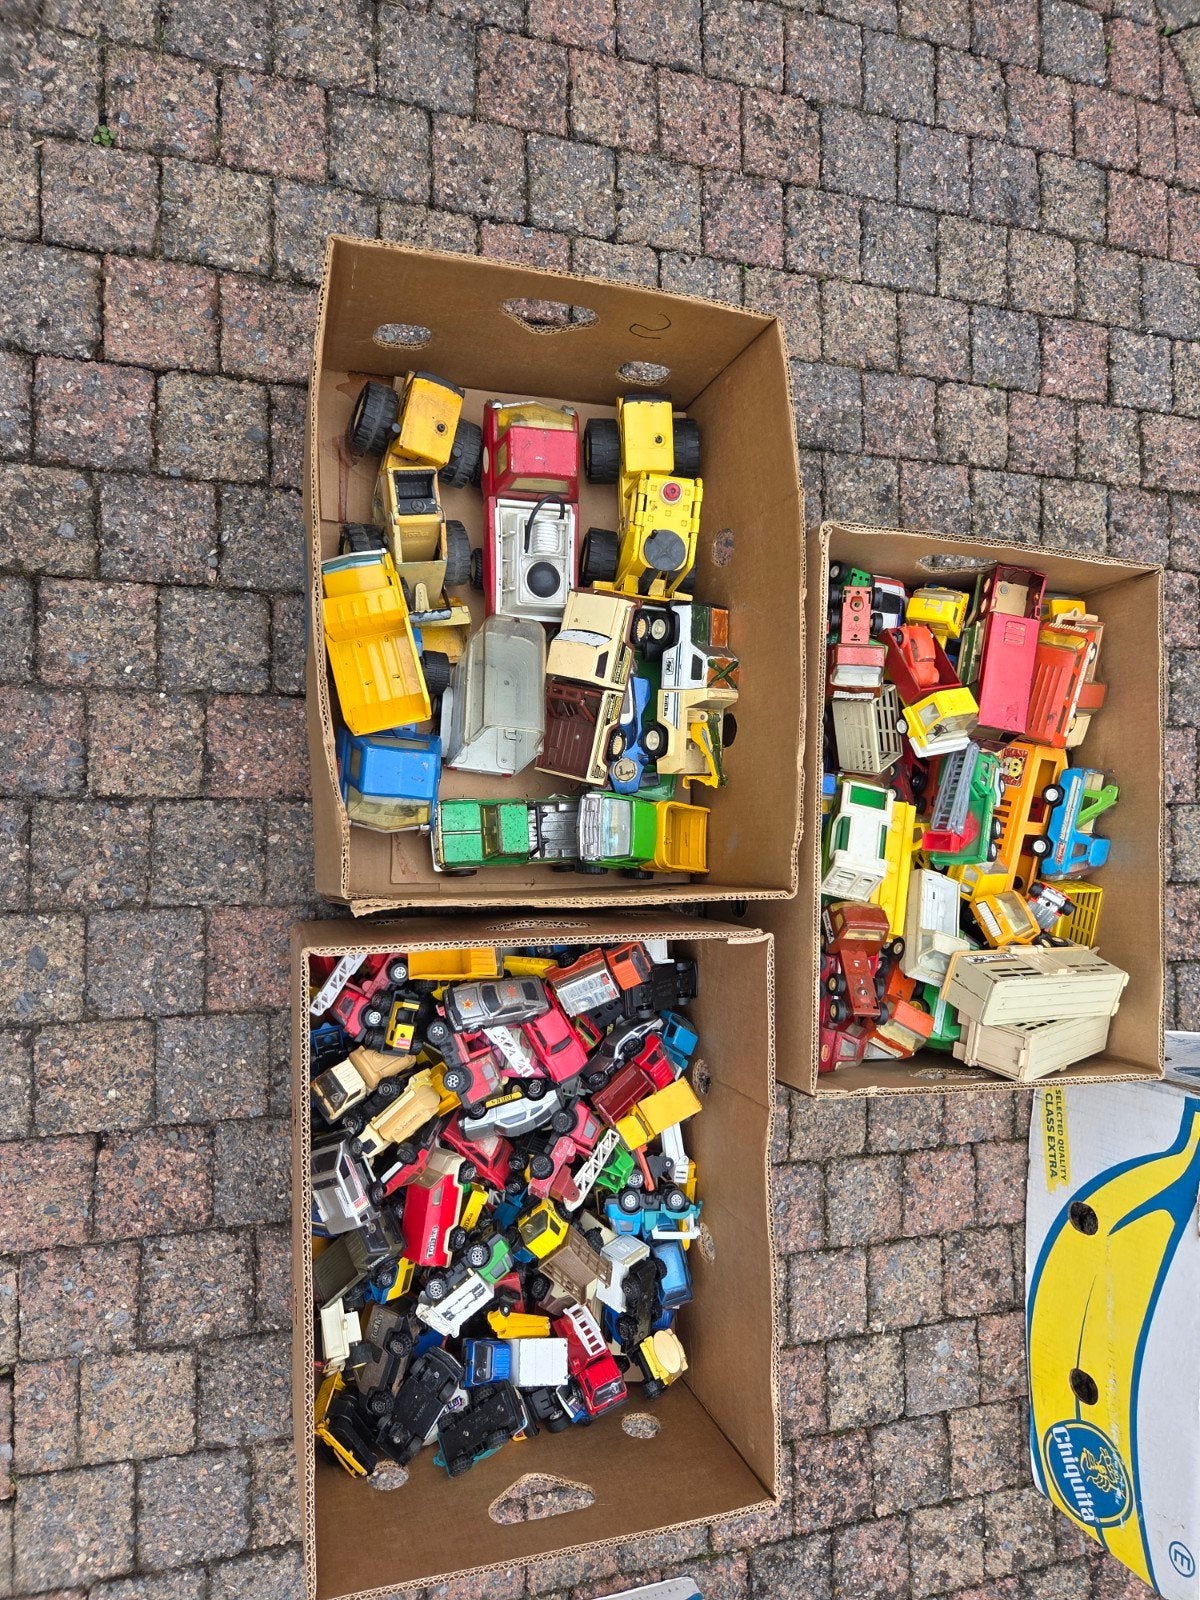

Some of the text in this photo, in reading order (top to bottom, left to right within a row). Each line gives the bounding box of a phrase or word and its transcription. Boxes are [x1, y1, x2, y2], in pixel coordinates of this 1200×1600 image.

[1045, 1093, 1058, 1178] CLASS EXTRA
[1055, 1089, 1067, 1181] SELECTED QUALITY
[1052, 1426, 1096, 1522] Chiquita
[1173, 1548, 1191, 1572] E
